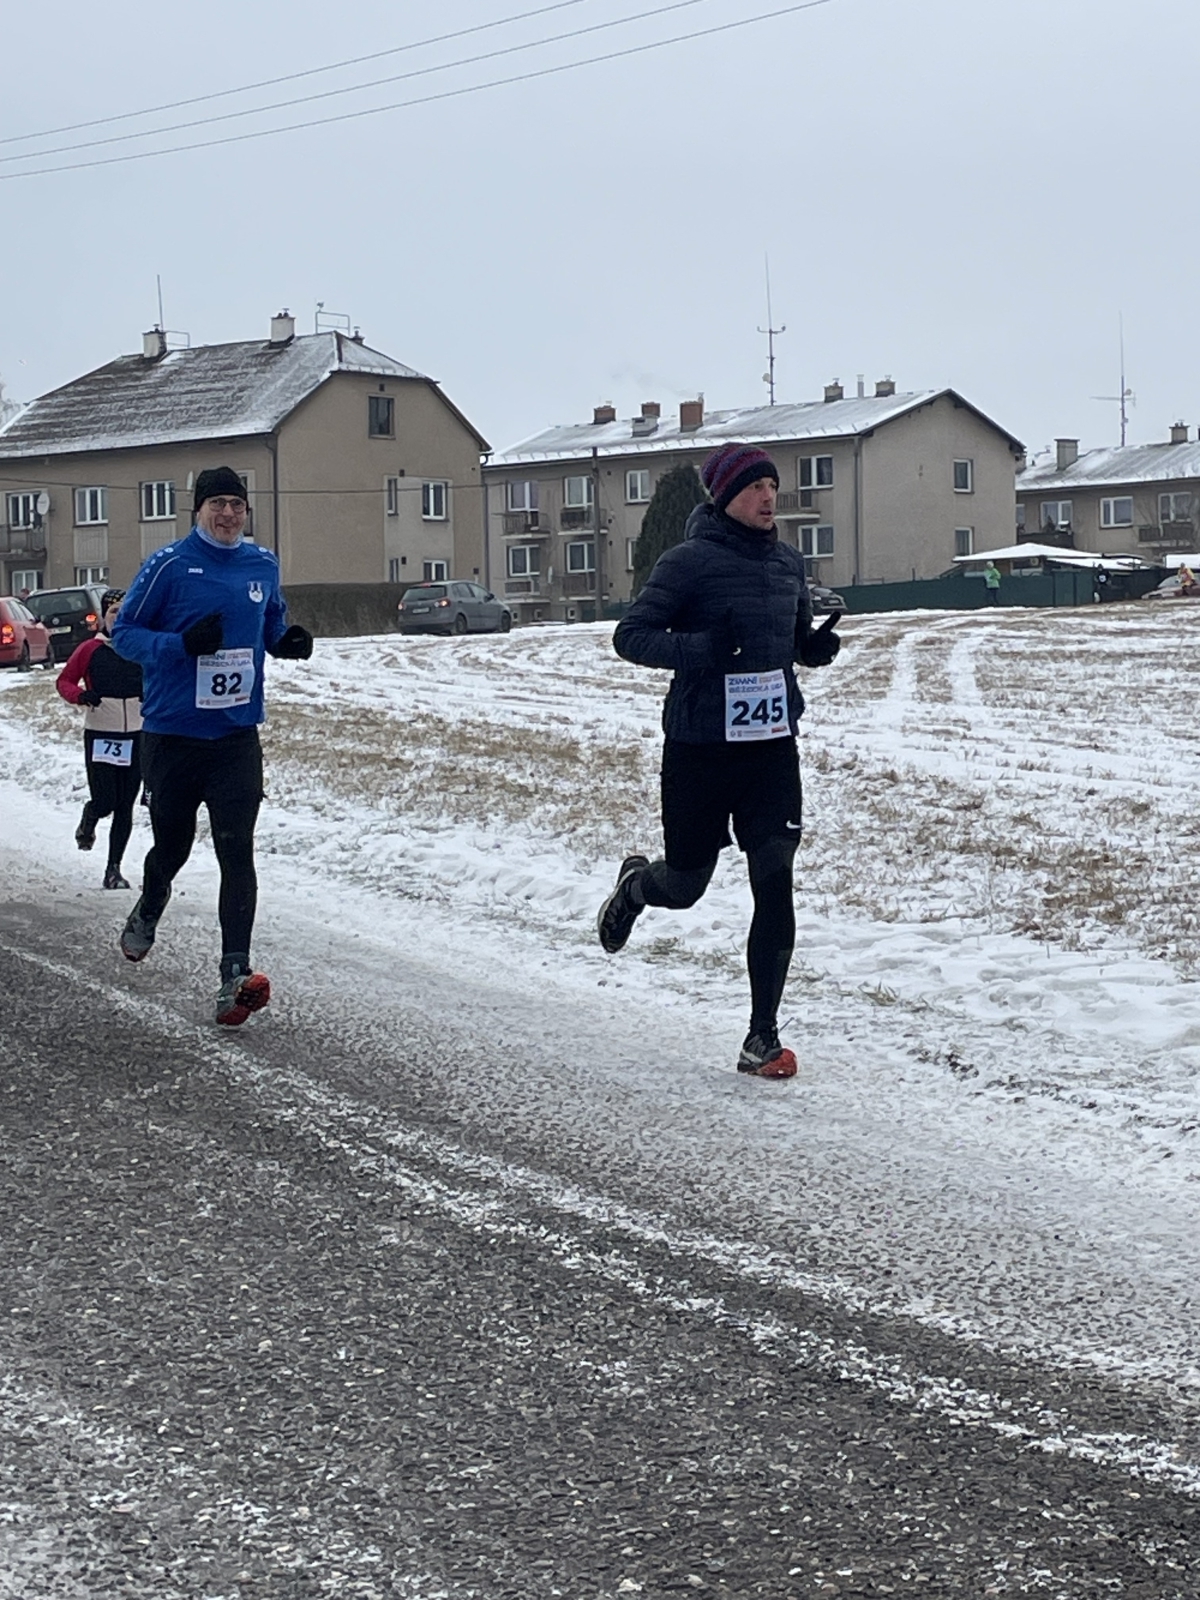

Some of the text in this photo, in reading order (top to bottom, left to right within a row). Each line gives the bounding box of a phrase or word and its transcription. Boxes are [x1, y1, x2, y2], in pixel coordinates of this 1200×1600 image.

[211, 672, 242, 696] 82
[731, 696, 783, 726] 245
[103, 740, 122, 757] 73
